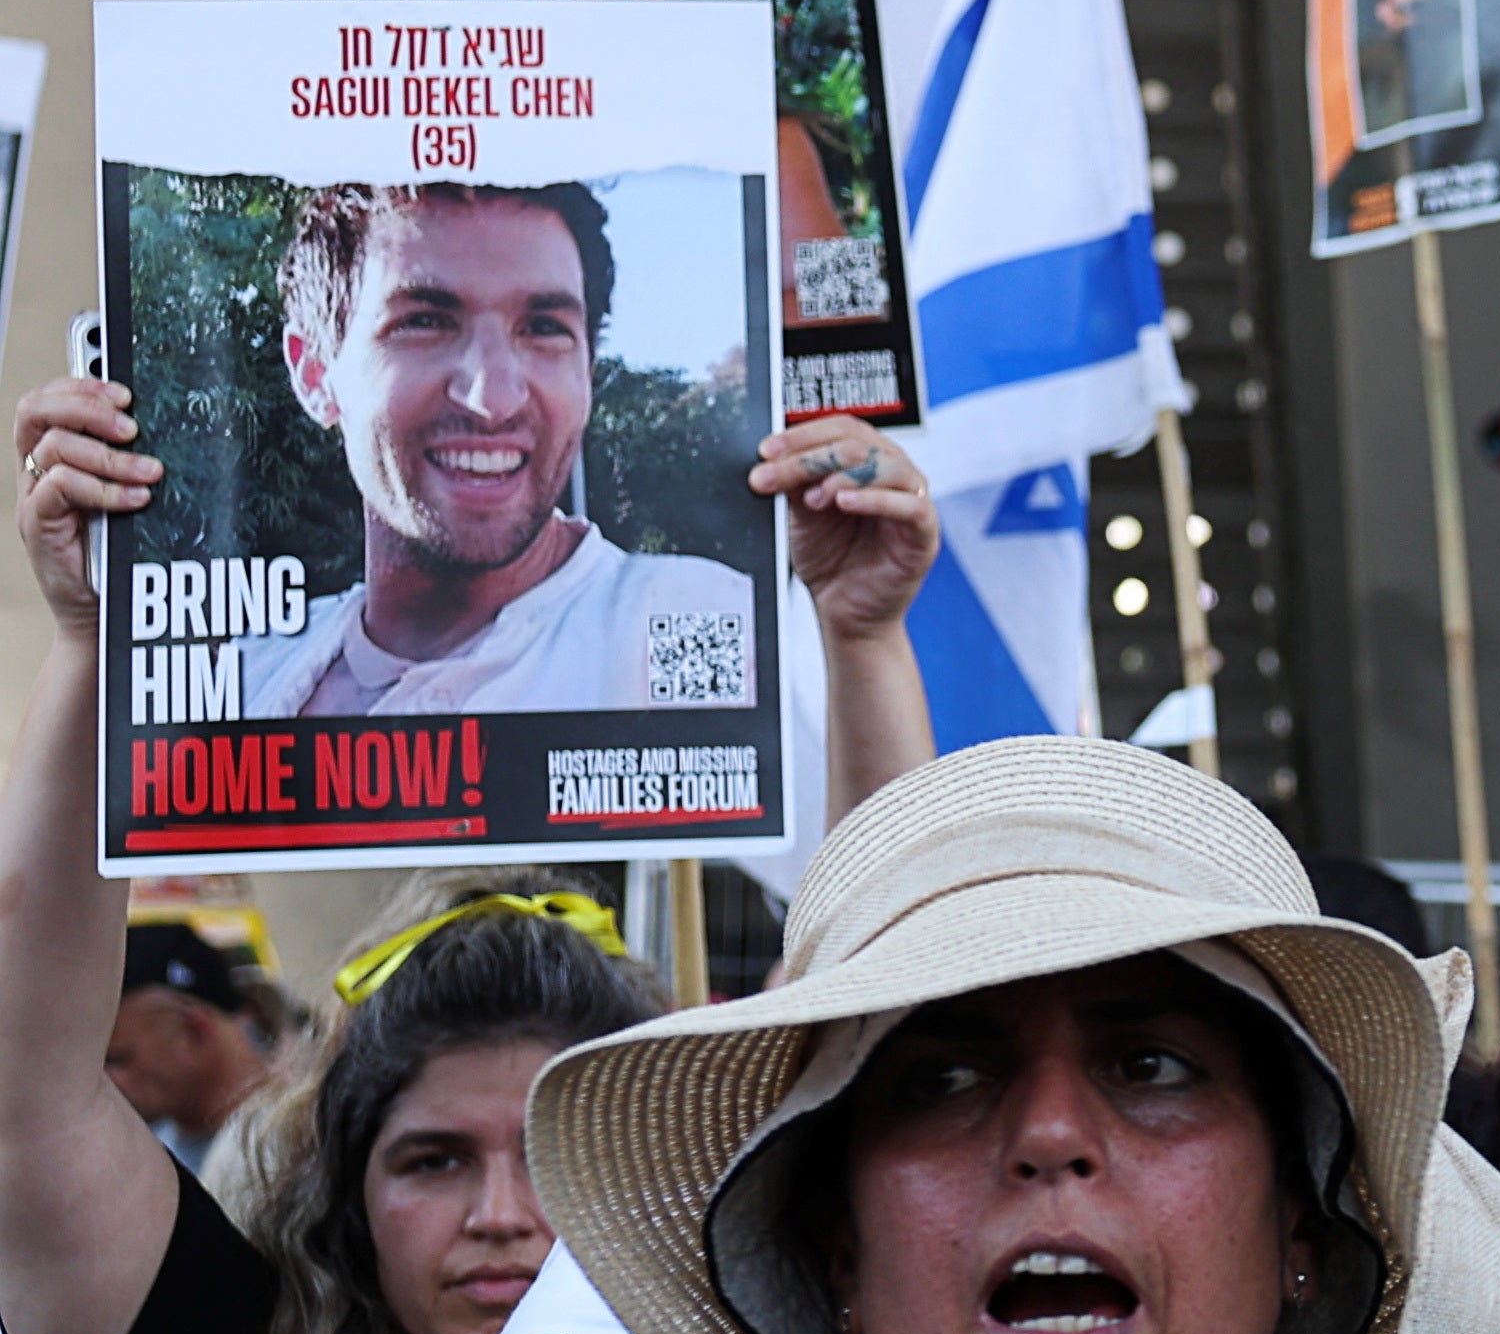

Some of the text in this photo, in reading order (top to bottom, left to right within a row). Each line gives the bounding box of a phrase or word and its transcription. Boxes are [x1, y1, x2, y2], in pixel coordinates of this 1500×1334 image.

[339, 23, 544, 72] שגיא דקל חן
[291, 76, 594, 118] SAGUI DEKEL CHEN
[411, 123, 477, 172] (35)
[131, 555, 307, 641] BRING
[131, 643, 241, 726] HIM
[131, 717, 489, 817] HOME NOW!
[547, 744, 758, 778] HOSTAGES AND MISSING
[549, 772, 759, 816] FAMILIES FORUM
